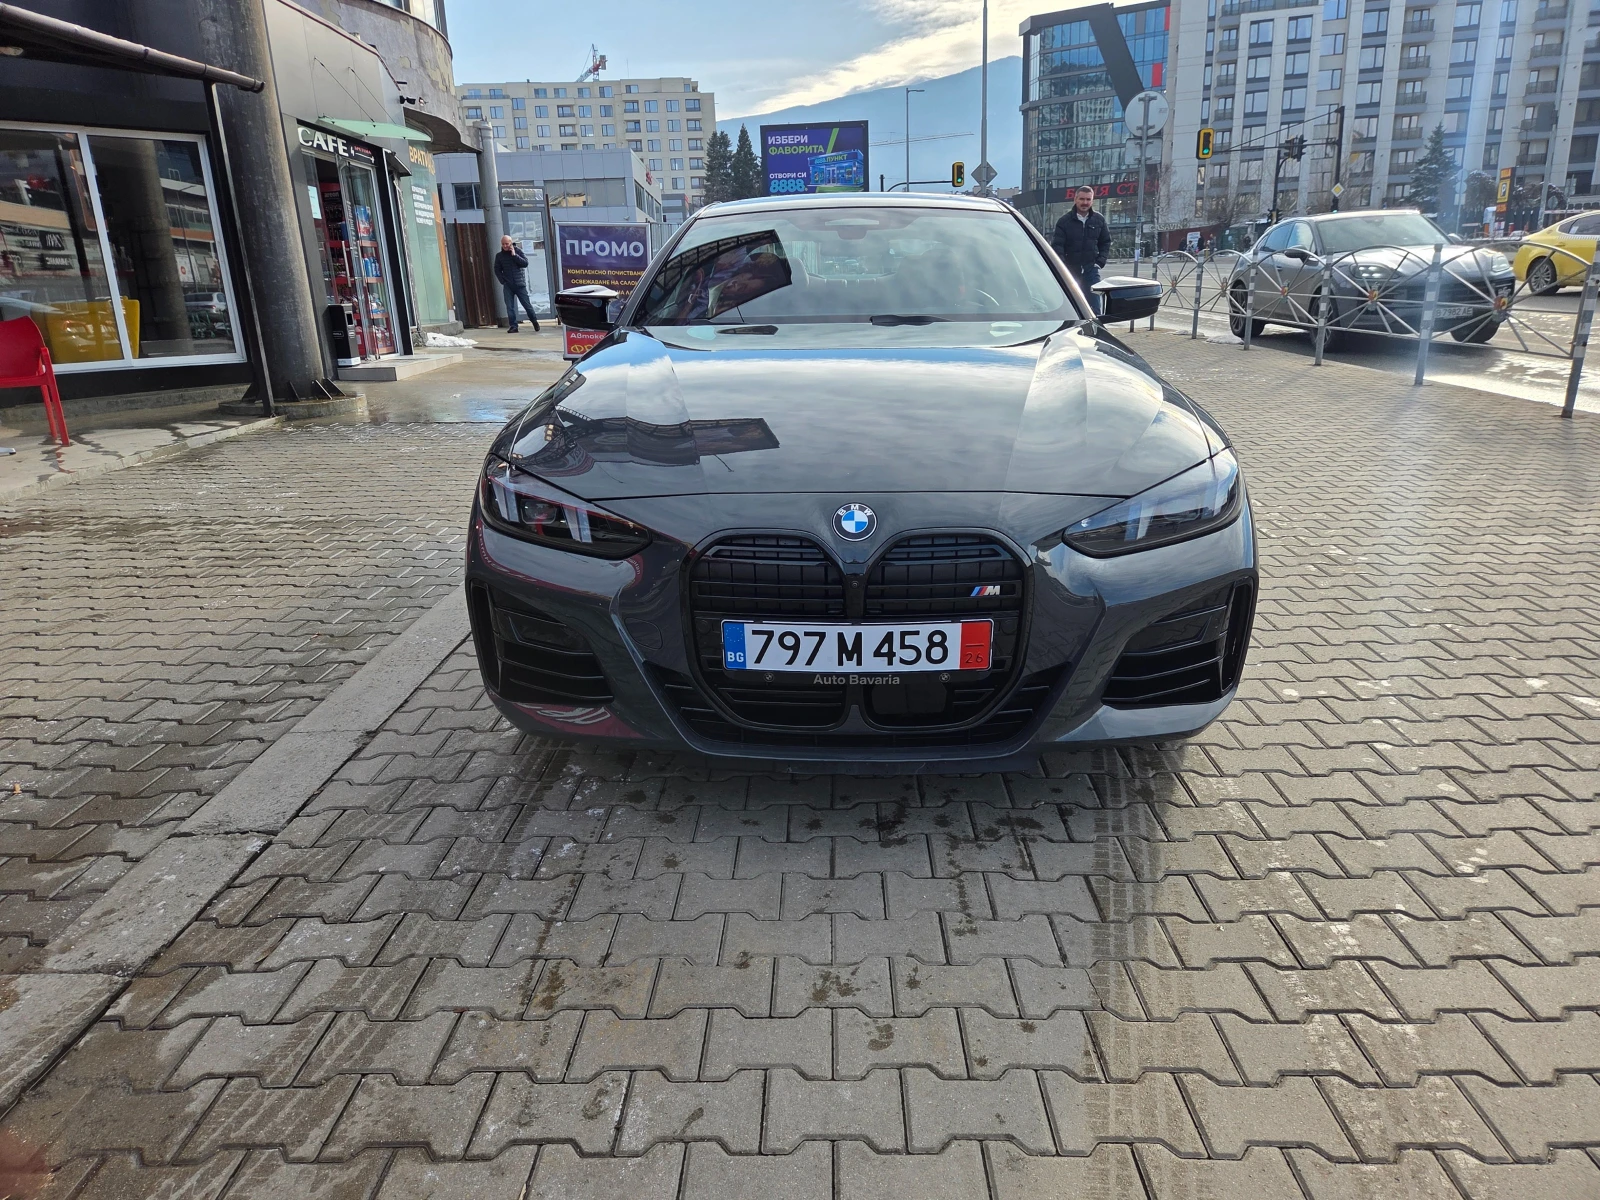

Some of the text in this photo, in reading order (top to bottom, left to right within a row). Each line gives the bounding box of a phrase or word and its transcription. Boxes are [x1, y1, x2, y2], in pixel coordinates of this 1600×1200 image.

[297, 127, 349, 157] CAFE
[768, 135, 808, 145] ИЗБЕРИ
[768, 145, 825, 155] ФАВОРИТА
[565, 239, 644, 257] ПРОМО
[567, 268, 607, 276] КОМПЛЕКСНО
[837, 503, 873, 516] BMW
[751, 629, 949, 667] 797 M 458
[727, 651, 745, 663] BG
[965, 651, 984, 664] 26
[813, 673, 900, 685] Auto Bavaria
